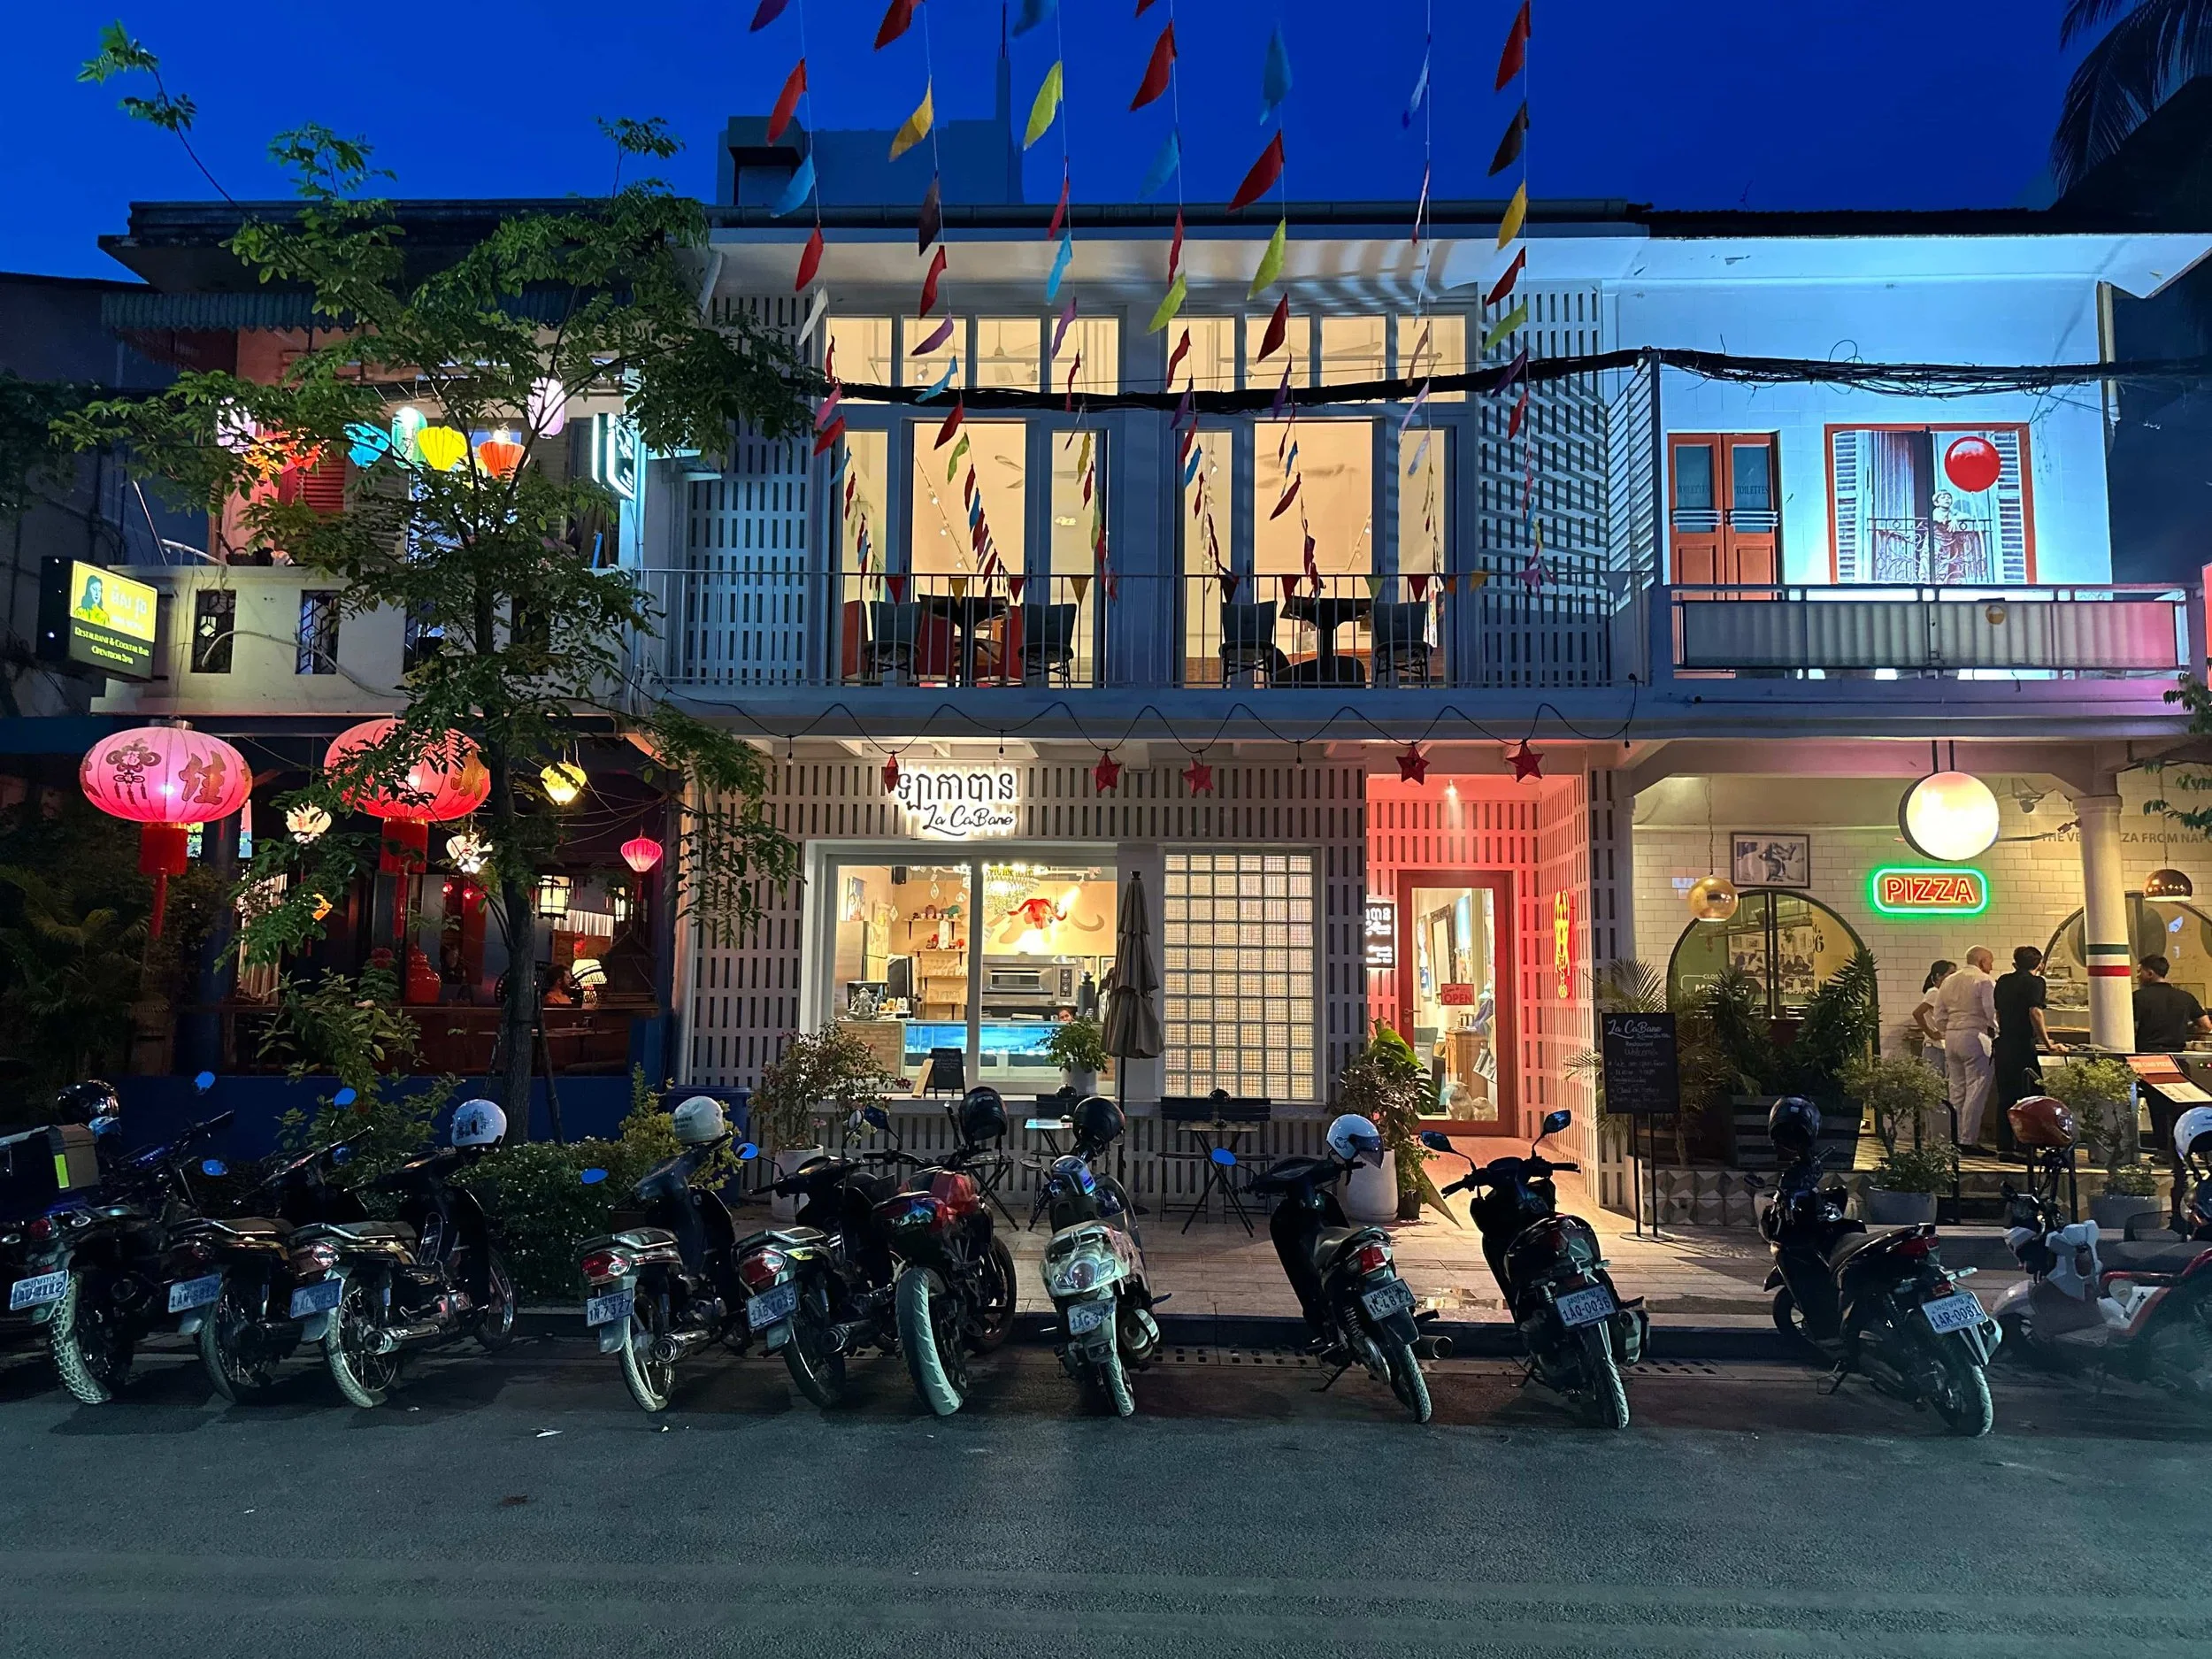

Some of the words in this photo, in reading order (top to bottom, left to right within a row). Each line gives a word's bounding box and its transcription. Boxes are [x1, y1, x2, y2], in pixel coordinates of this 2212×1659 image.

[1736, 486, 1769, 495] TOILETTES
[2141, 833, 2177, 843] FROM
[1885, 877, 1977, 903] PIZZA
[1444, 994, 1472, 1003] OPEN
[589, 1300, 631, 1321] 1N-7327
[1369, 1289, 1411, 1315] 1C-4822
[1563, 1296, 1610, 1321] 1AQ-0036
[1932, 1304, 1981, 1327] 1AR-0081
